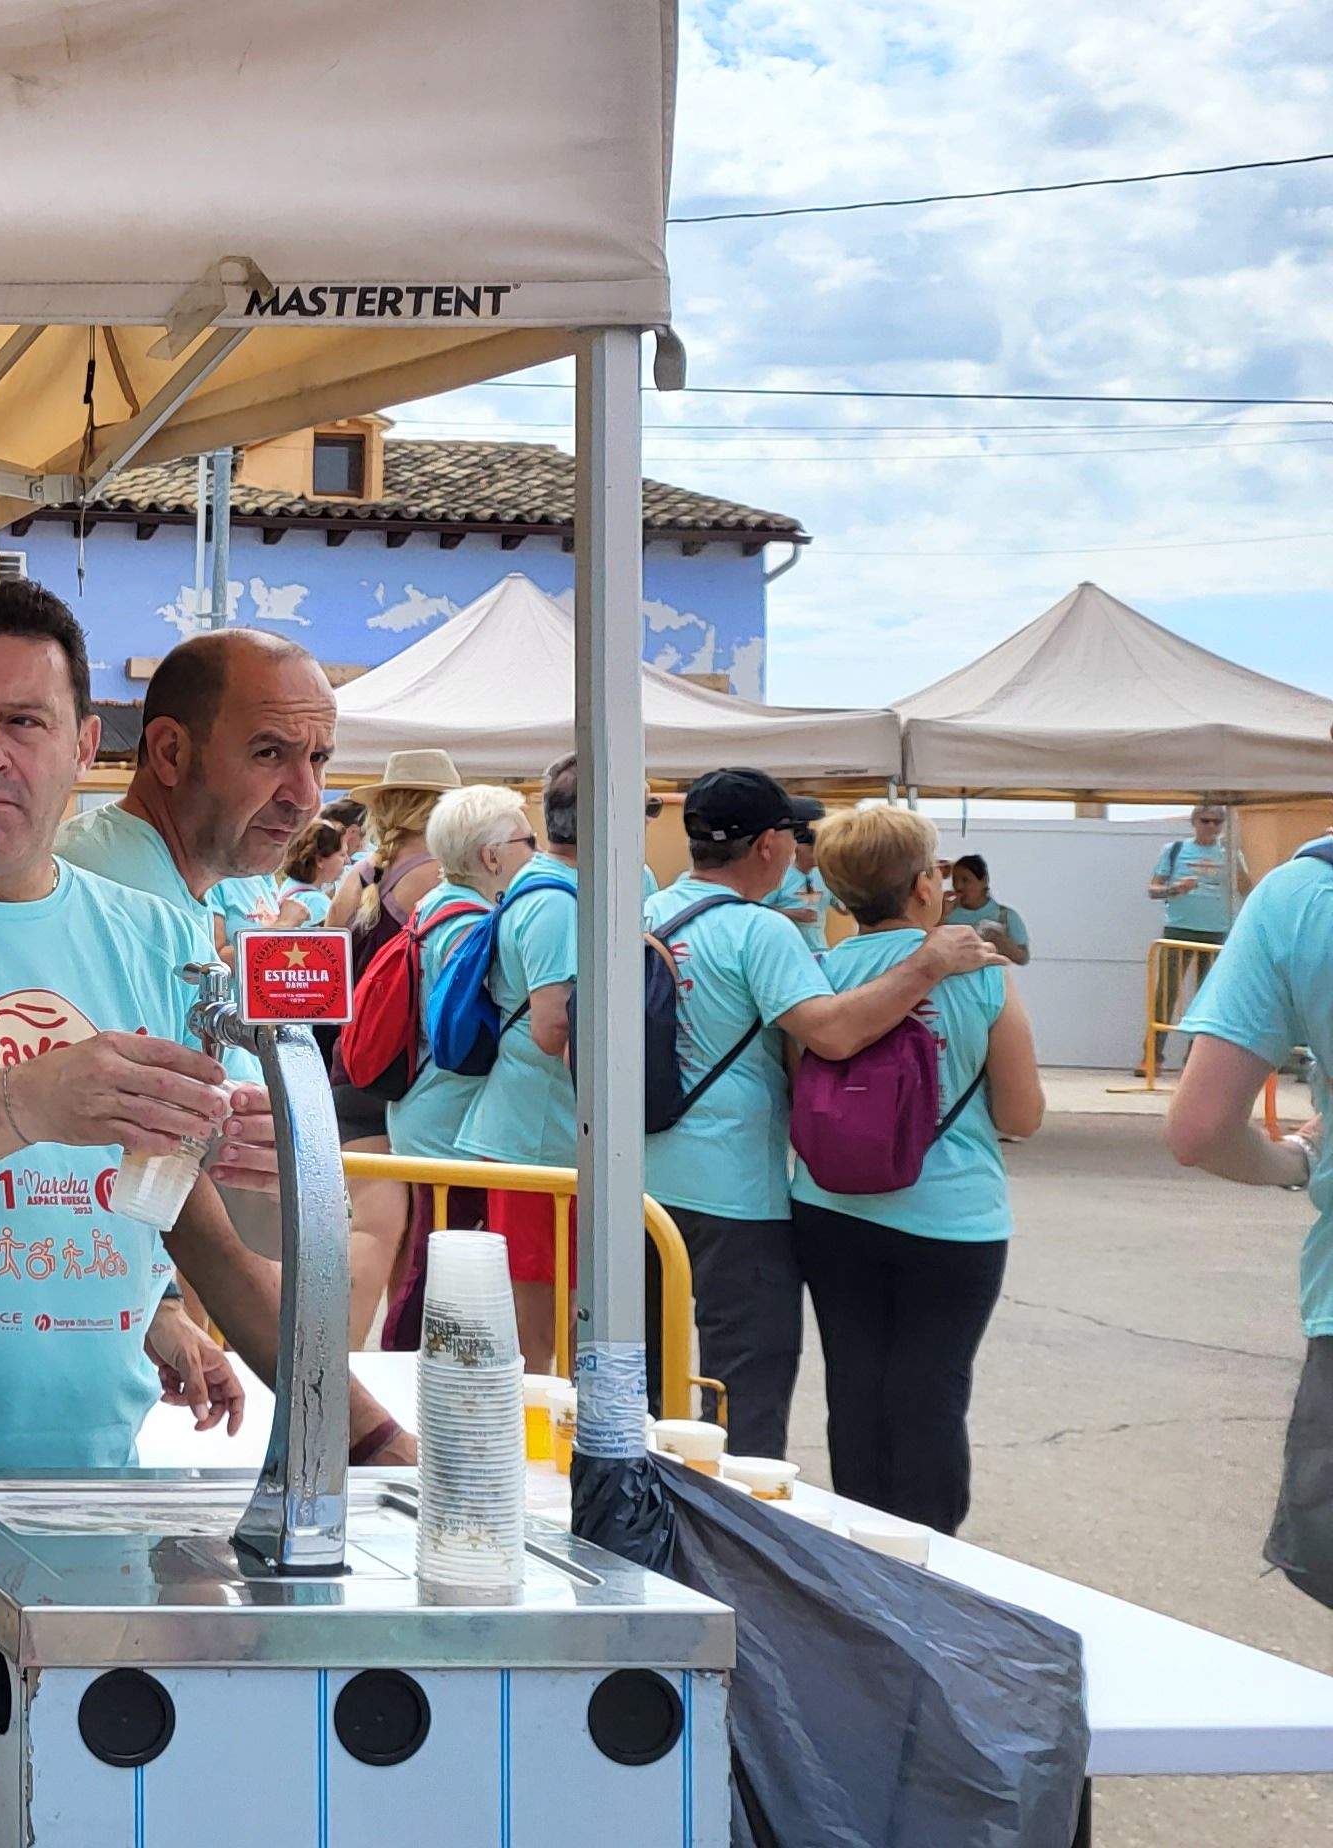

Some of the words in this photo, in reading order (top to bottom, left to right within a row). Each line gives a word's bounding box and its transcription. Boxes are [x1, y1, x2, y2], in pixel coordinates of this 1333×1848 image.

[244, 285, 512, 316] MASTERTENT
[264, 969, 330, 982] ESTRELLA
[24, 1169, 91, 1194] Marcha
[27, 1196, 59, 1206] ASPACE
